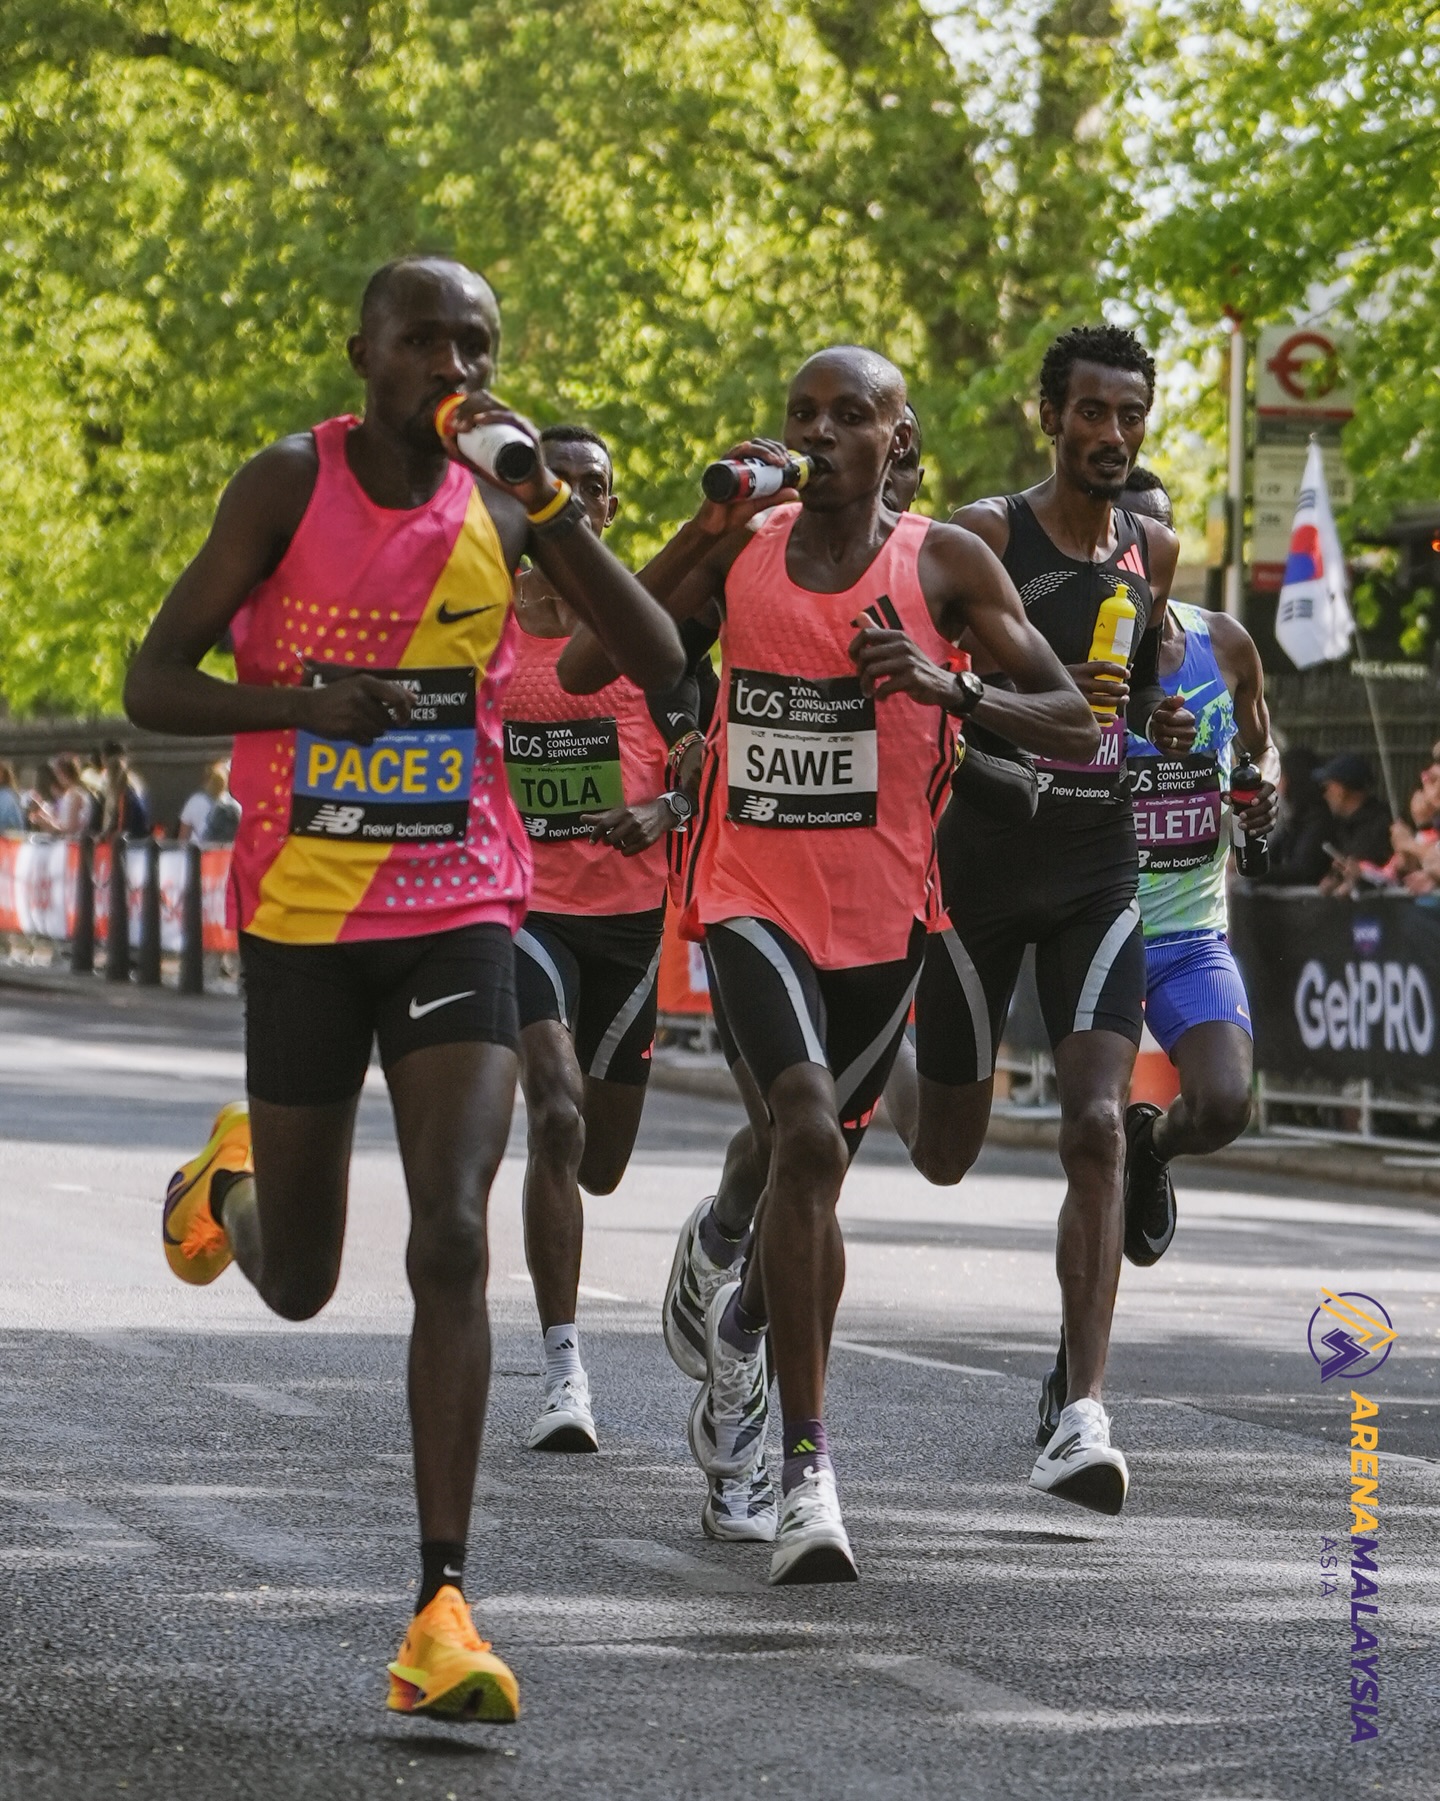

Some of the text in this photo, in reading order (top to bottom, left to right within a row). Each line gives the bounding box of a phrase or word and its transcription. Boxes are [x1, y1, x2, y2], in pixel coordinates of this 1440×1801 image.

[415, 692, 468, 705] ULTANCY
[789, 686, 821, 698] TATA
[736, 679, 784, 719] tcs
[789, 698, 866, 711] CONSULTANCY
[789, 711, 838, 724] SERVICES
[546, 729, 573, 739] TATA
[508, 728, 543, 758] tcs
[546, 735, 610, 748] CONSULTANCY
[547, 747, 588, 758] SERVICES
[307, 743, 463, 793] PACE 3
[746, 744, 853, 786] SAWE
[1157, 762, 1184, 771] TATA
[1157, 767, 1213, 781] CONSULTANCY
[520, 776, 602, 808] TOLA
[1051, 786, 1110, 798] new balance
[1157, 780, 1195, 791] SERVICES
[778, 811, 862, 824] new balance
[1133, 806, 1216, 840] ELETA
[362, 821, 454, 836] new balance
[549, 824, 597, 837] new bala
[1150, 859, 1171, 869] new
[1294, 959, 1434, 1056] GetPRO
